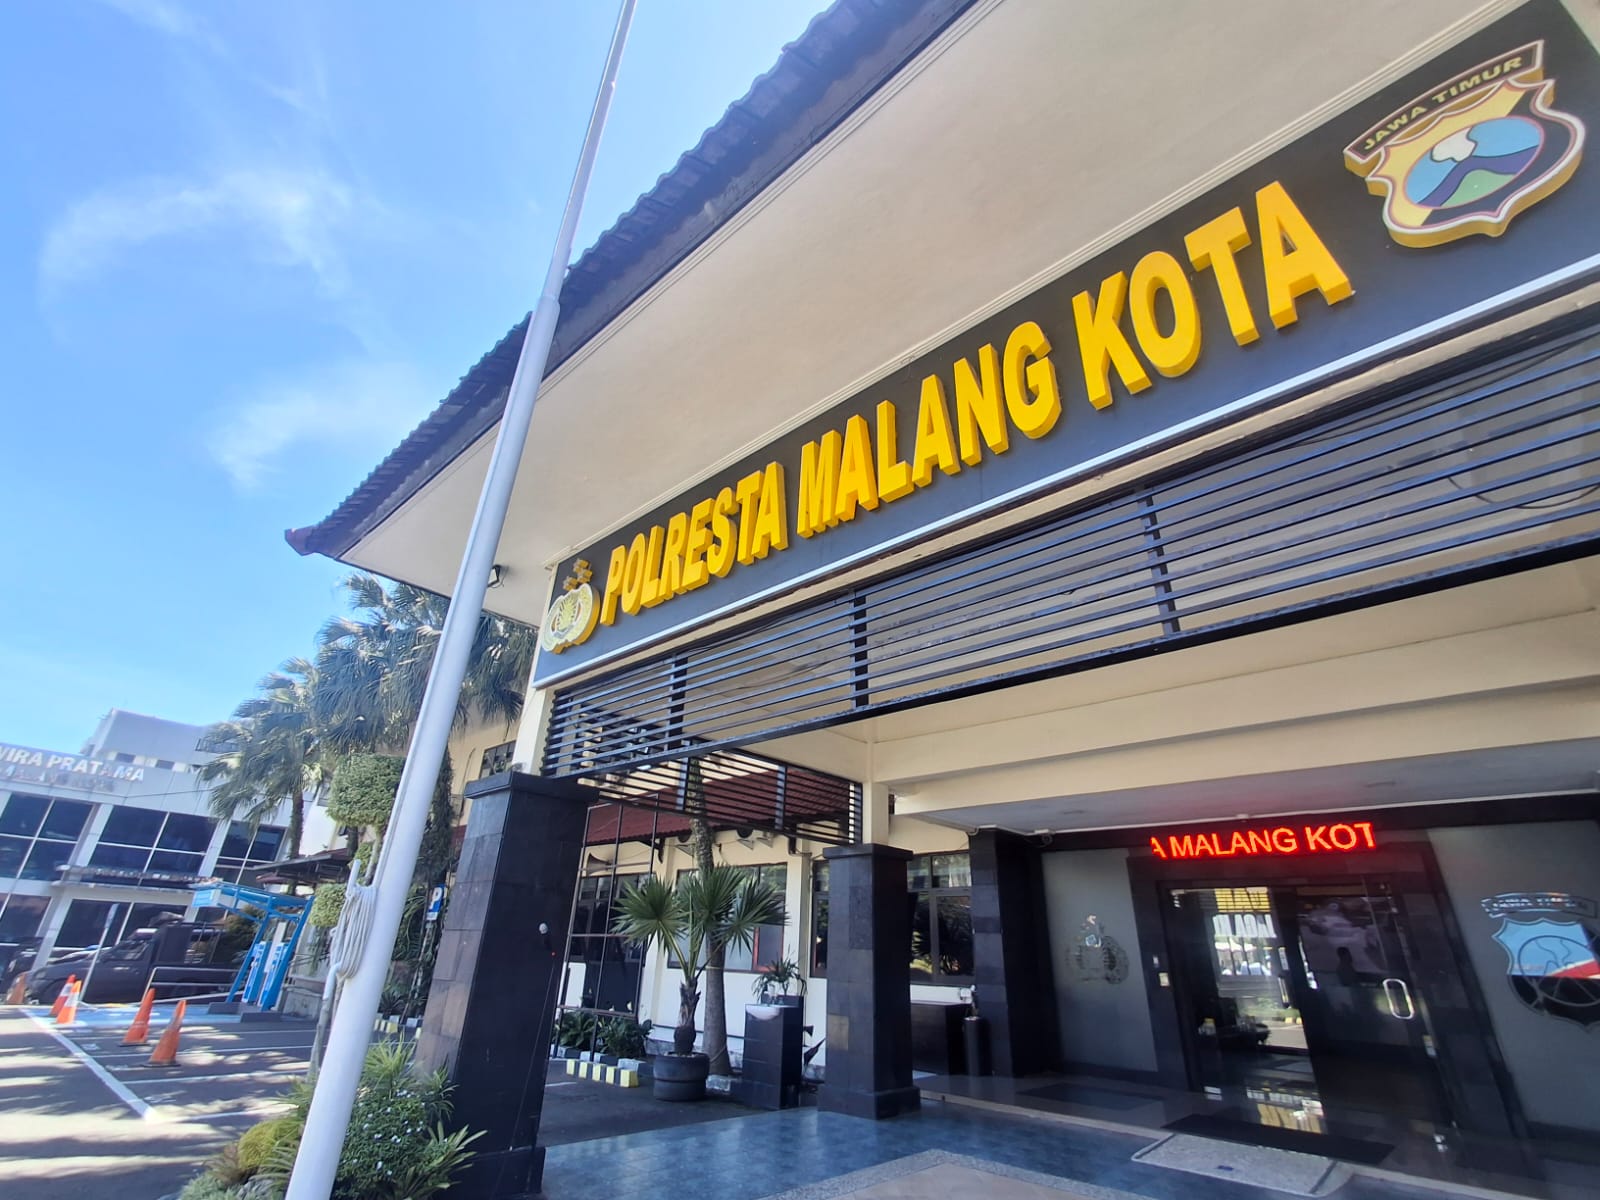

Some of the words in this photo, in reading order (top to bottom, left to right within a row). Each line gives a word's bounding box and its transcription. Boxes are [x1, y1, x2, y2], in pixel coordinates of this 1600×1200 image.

[1364, 105, 1427, 150] JAWA
[1432, 56, 1522, 104] TIMUR
[600, 461, 789, 627] POLRESTA
[797, 321, 1062, 539] MALANG
[1072, 181, 1354, 411] KOTA
[46, 755, 145, 781] PRATAMA
[1168, 827, 1299, 859] MALANG
[1304, 822, 1376, 851] KOT
